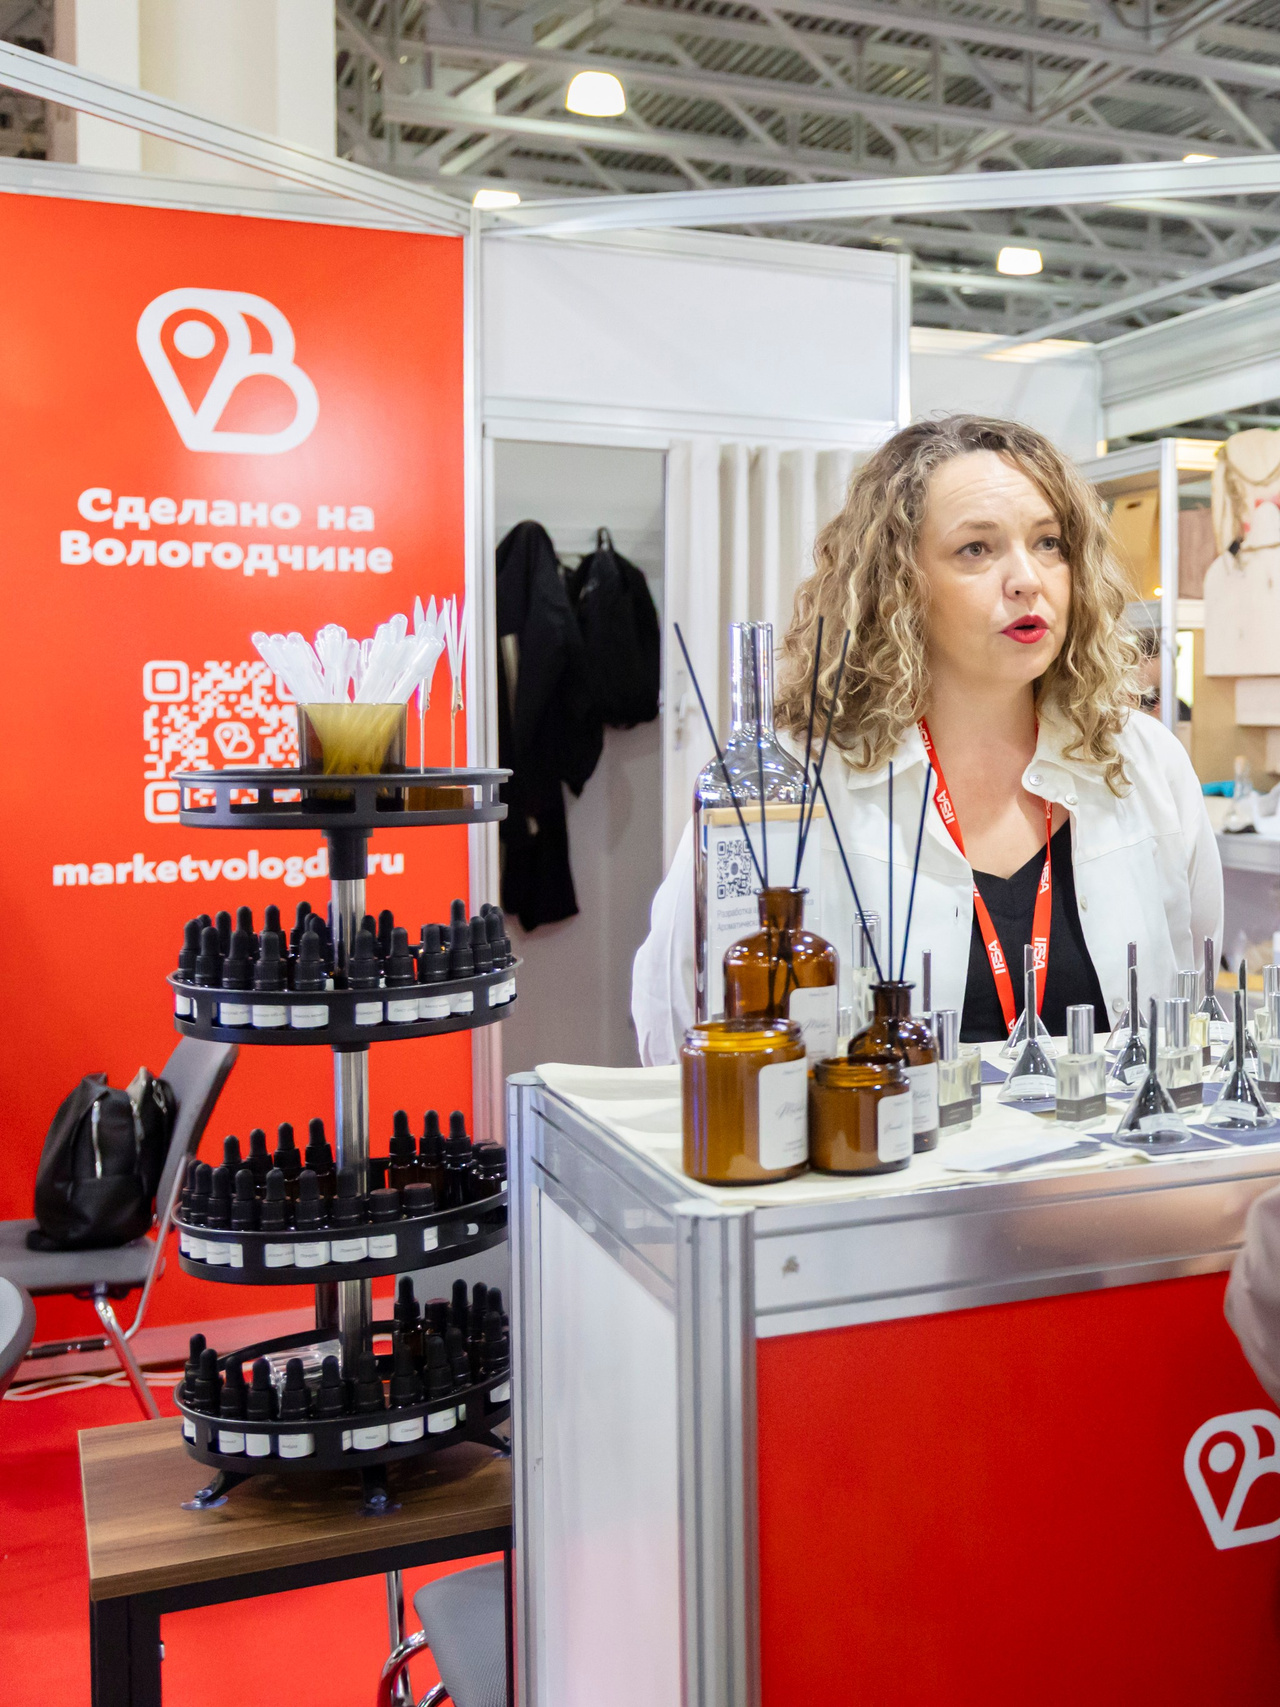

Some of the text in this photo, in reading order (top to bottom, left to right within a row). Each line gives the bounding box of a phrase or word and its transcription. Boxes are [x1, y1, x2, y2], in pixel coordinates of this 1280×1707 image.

[77, 487, 376, 532] Сделано на
[60, 530, 393, 578] Вологодчине
[936, 789, 956, 825] IFSA
[52, 847, 404, 887] marketvologdru
[988, 939, 1006, 975] IFSA
[1033, 937, 1047, 971] IFSA
